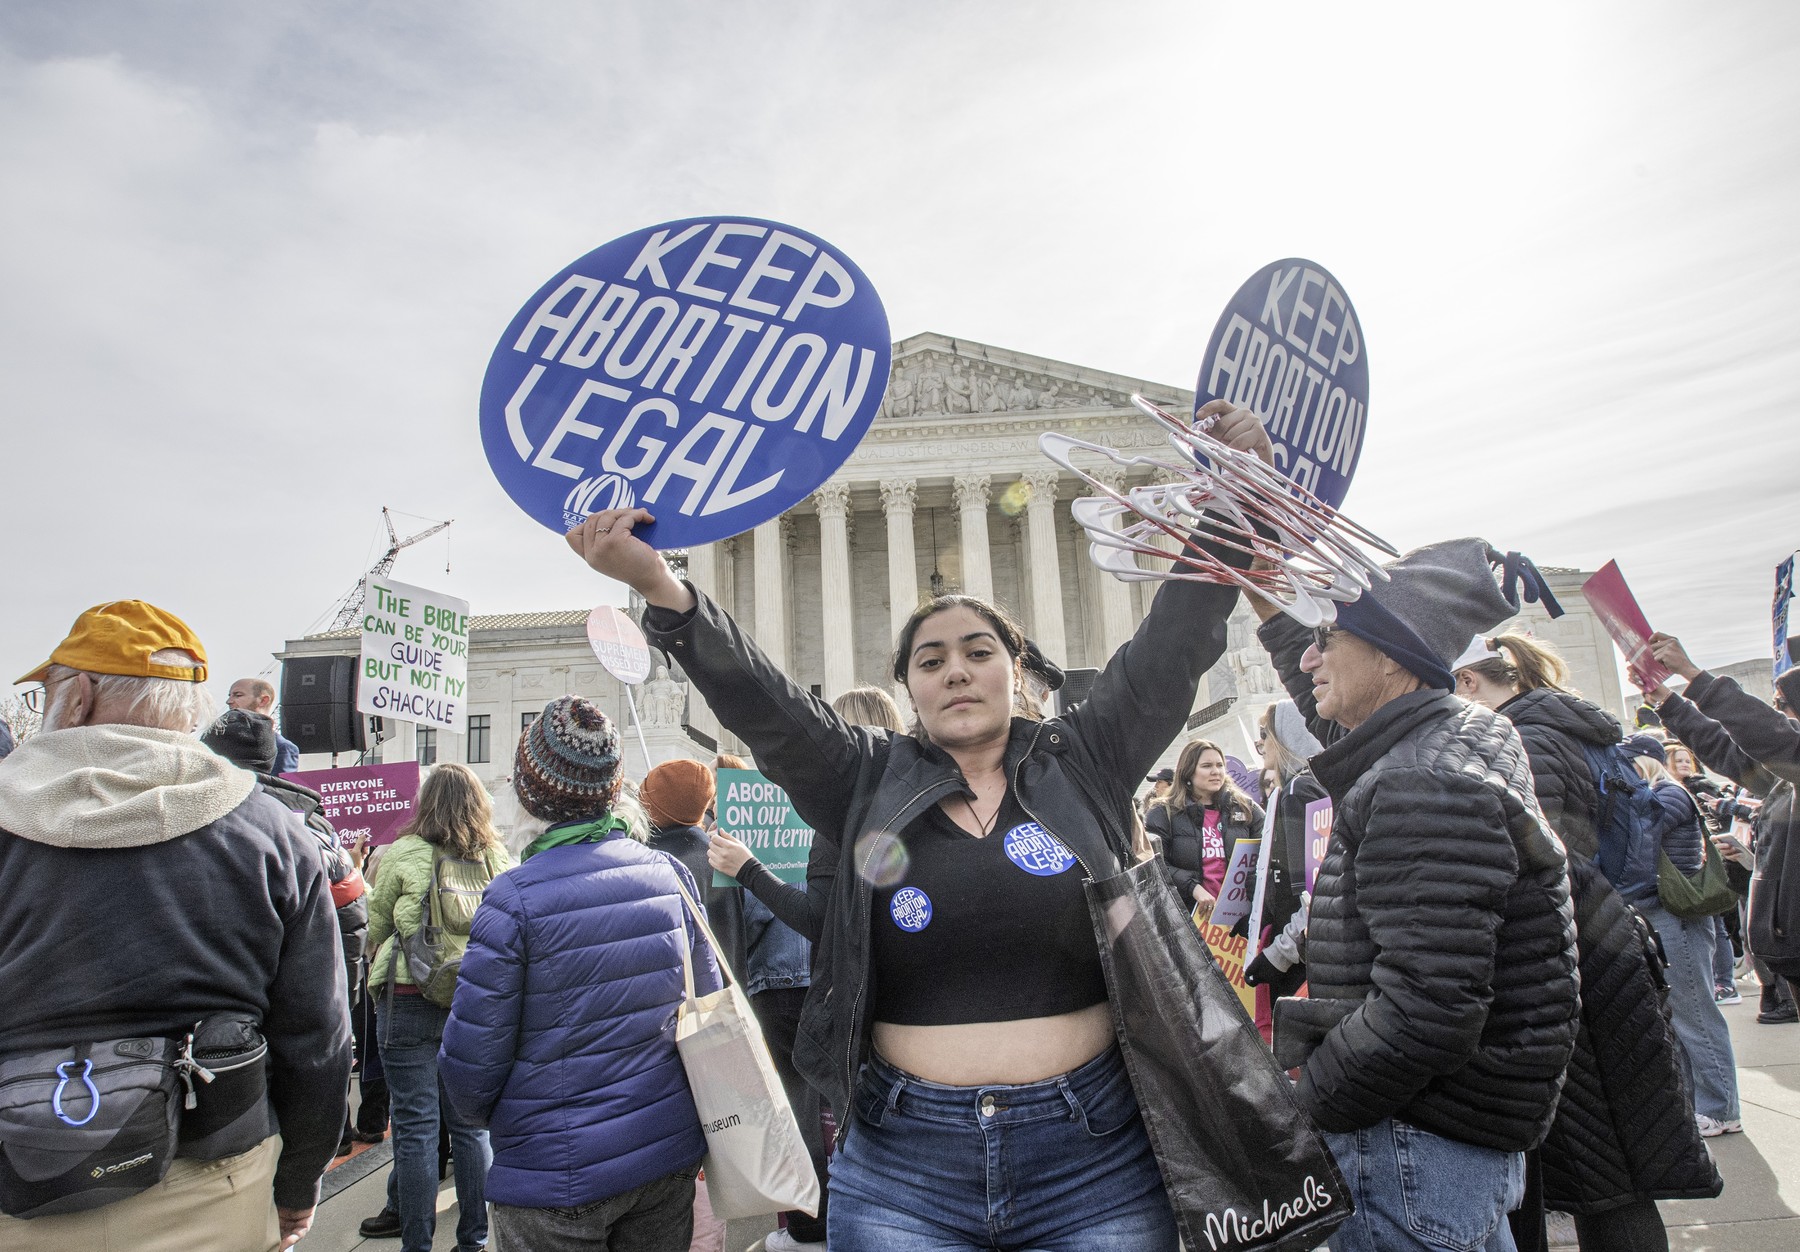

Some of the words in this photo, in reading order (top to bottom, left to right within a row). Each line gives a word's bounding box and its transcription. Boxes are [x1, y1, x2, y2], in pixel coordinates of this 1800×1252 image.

[623, 223, 856, 322] KEEP
[1259, 266, 1360, 377] KEEP
[512, 273, 876, 442] ABORTION
[1207, 311, 1364, 478] ABORTION
[504, 363, 786, 517] LEGAL
[890, 445, 943, 458] JUSTICE
[950, 441, 998, 454] UNDER
[1005, 439, 1030, 452] LAW
[372, 584, 411, 618] THE
[423, 604, 469, 638] BIBLE
[363, 614, 396, 636] CAN
[404, 624, 425, 644] BE
[431, 631, 468, 660] YOUR
[390, 641, 443, 672] GUIDE
[365, 657, 403, 682] BUT
[410, 668, 441, 692] NOT
[444, 675, 466, 698] MY
[372, 685, 455, 725] SHACKLE
[320, 778, 384, 793] EVERYONE
[372, 788, 397, 800] THE
[345, 805, 363, 816] TO
[367, 799, 411, 814] DECIDE
[725, 805, 753, 826] ON
[757, 805, 791, 826] our
[773, 825, 816, 848] term
[1009, 822, 1045, 841] KEE
[1006, 833, 1061, 860] ABORTI
[892, 894, 927, 921] ABORTION
[893, 889, 915, 907] KEEP
[900, 908, 928, 928] LEGAL
[1199, 919, 1249, 960] ABOR
[703, 1113, 741, 1135] museum
[1202, 1175, 1333, 1251] Michaels
